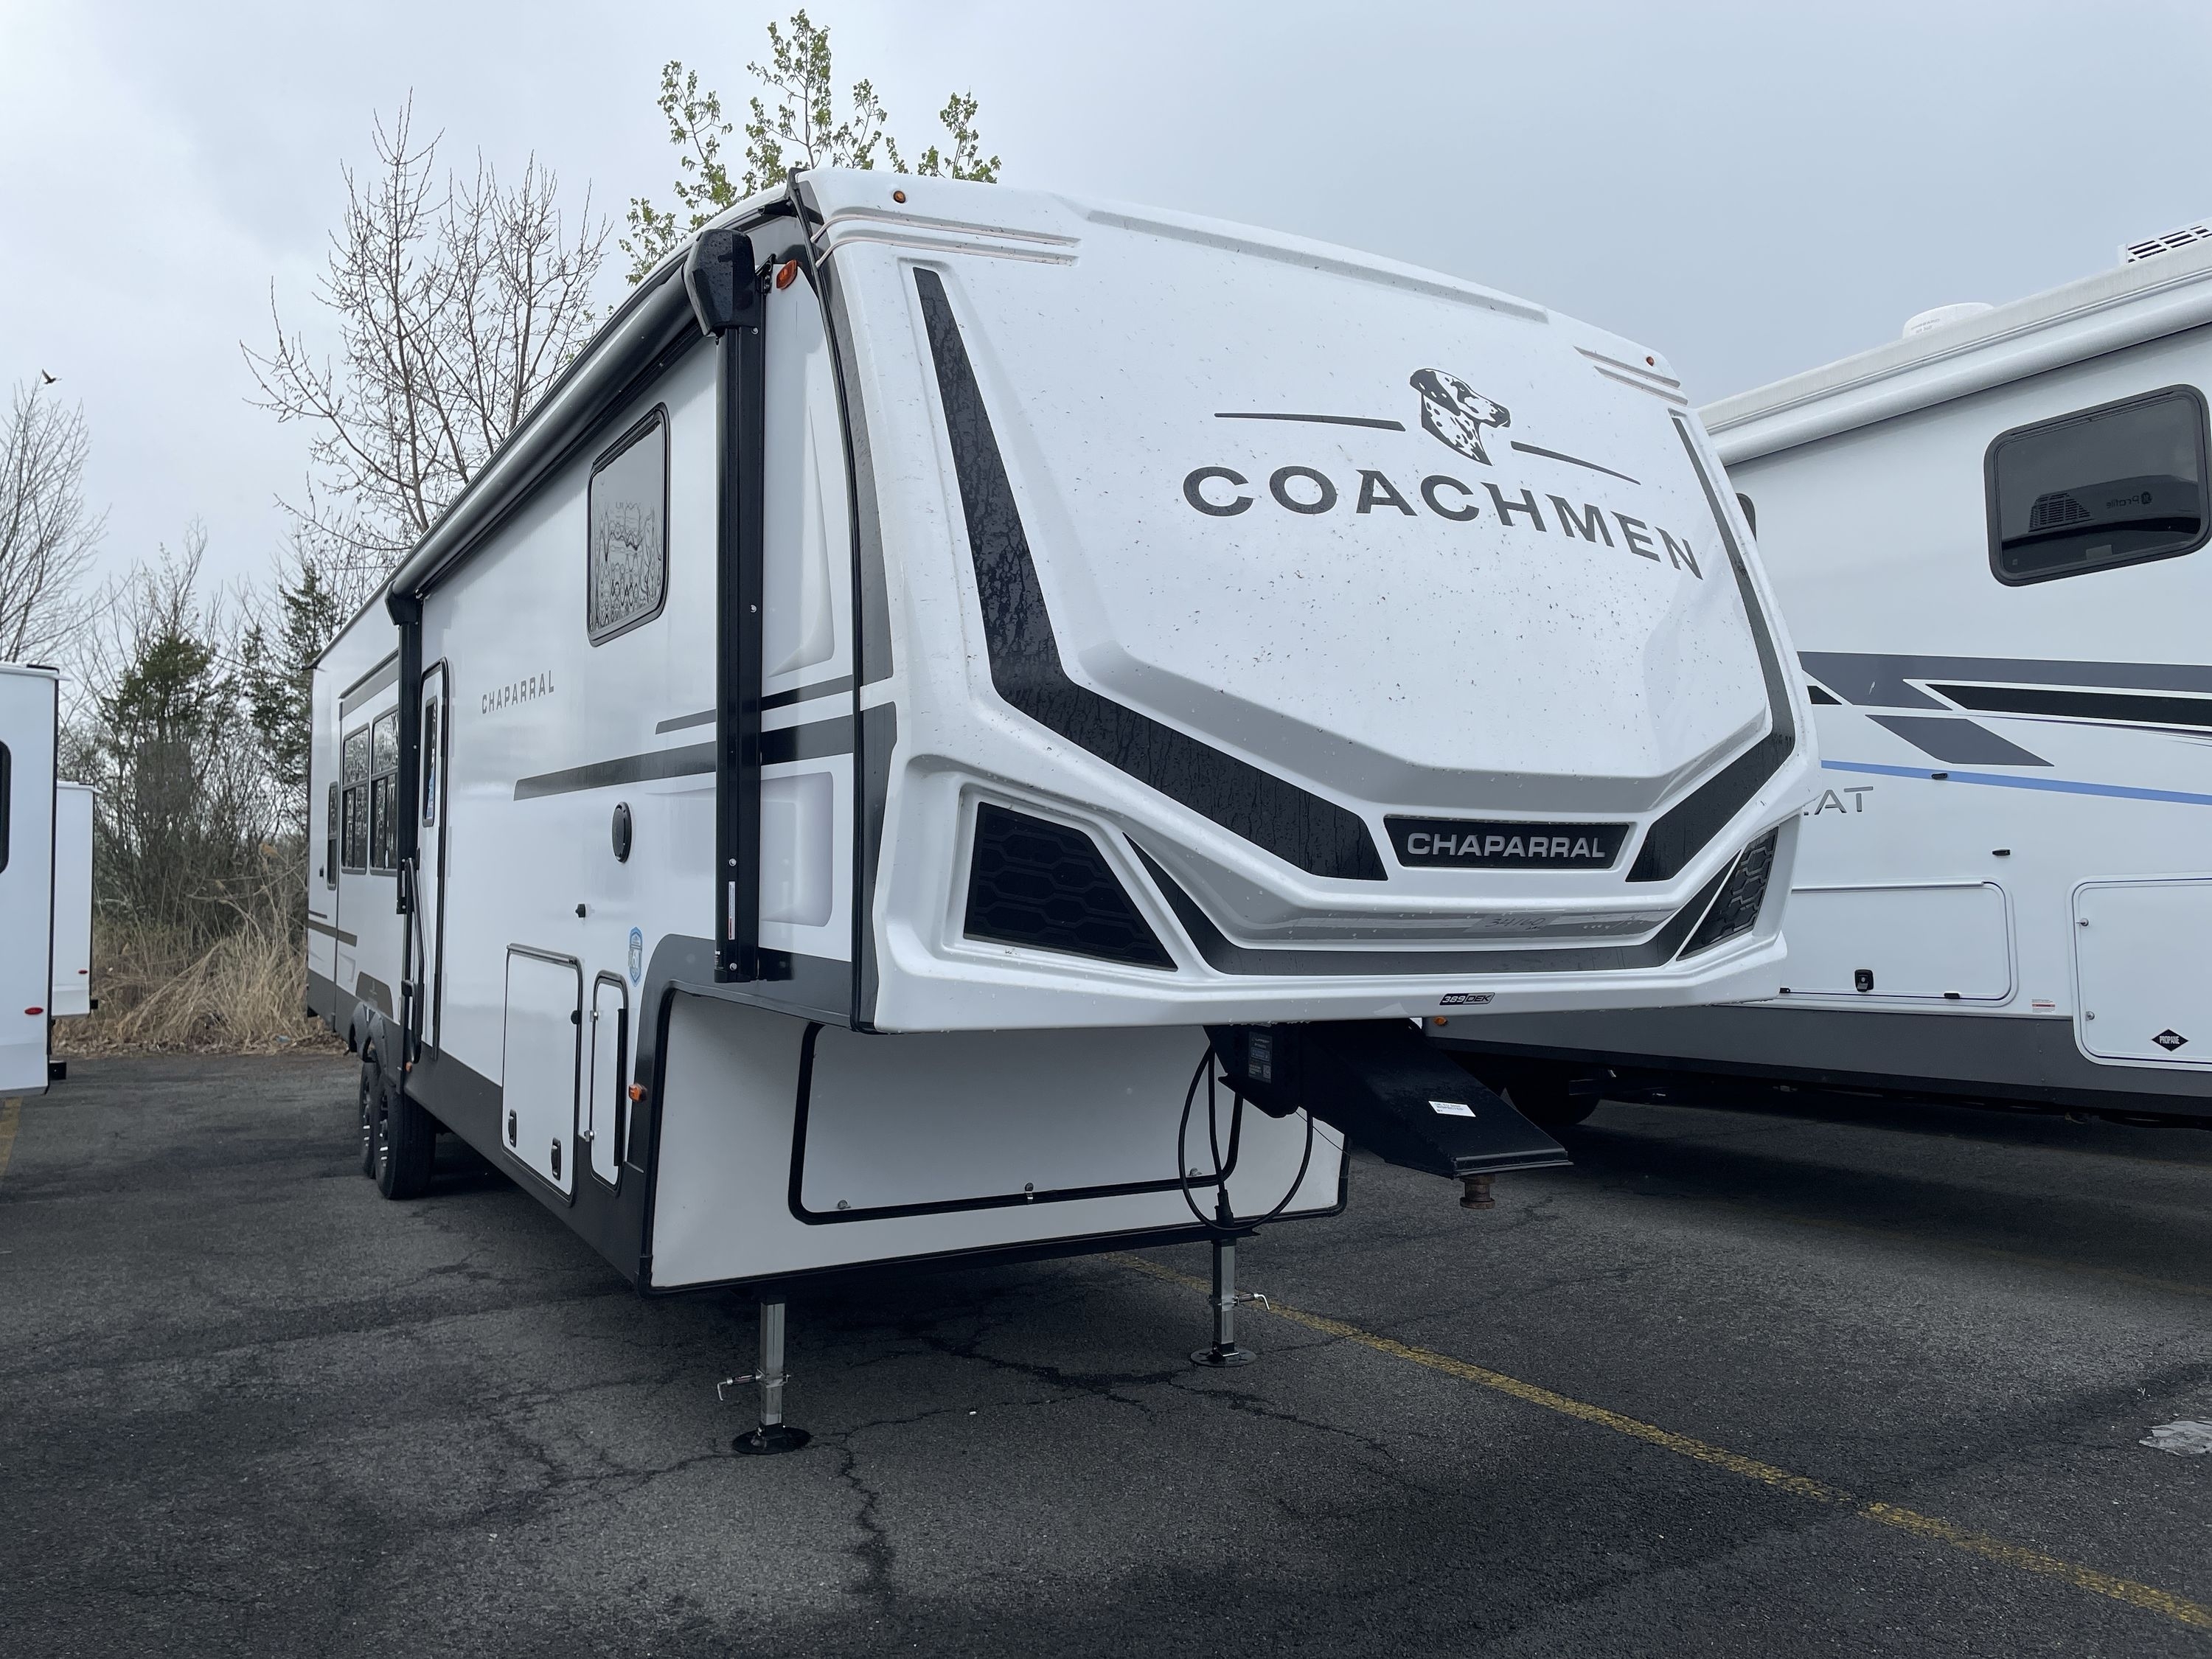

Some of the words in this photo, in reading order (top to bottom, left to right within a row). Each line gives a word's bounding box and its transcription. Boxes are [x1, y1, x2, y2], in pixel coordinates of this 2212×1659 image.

[1182, 466, 1704, 581] COACHMEN
[481, 669, 554, 714] CHAPARRAL
[1804, 786, 1874, 815] AT
[1407, 832, 1606, 858] CHAPARRAL
[1465, 995, 1492, 1003] DEK
[2159, 1035, 2180, 1044] PROPANE
